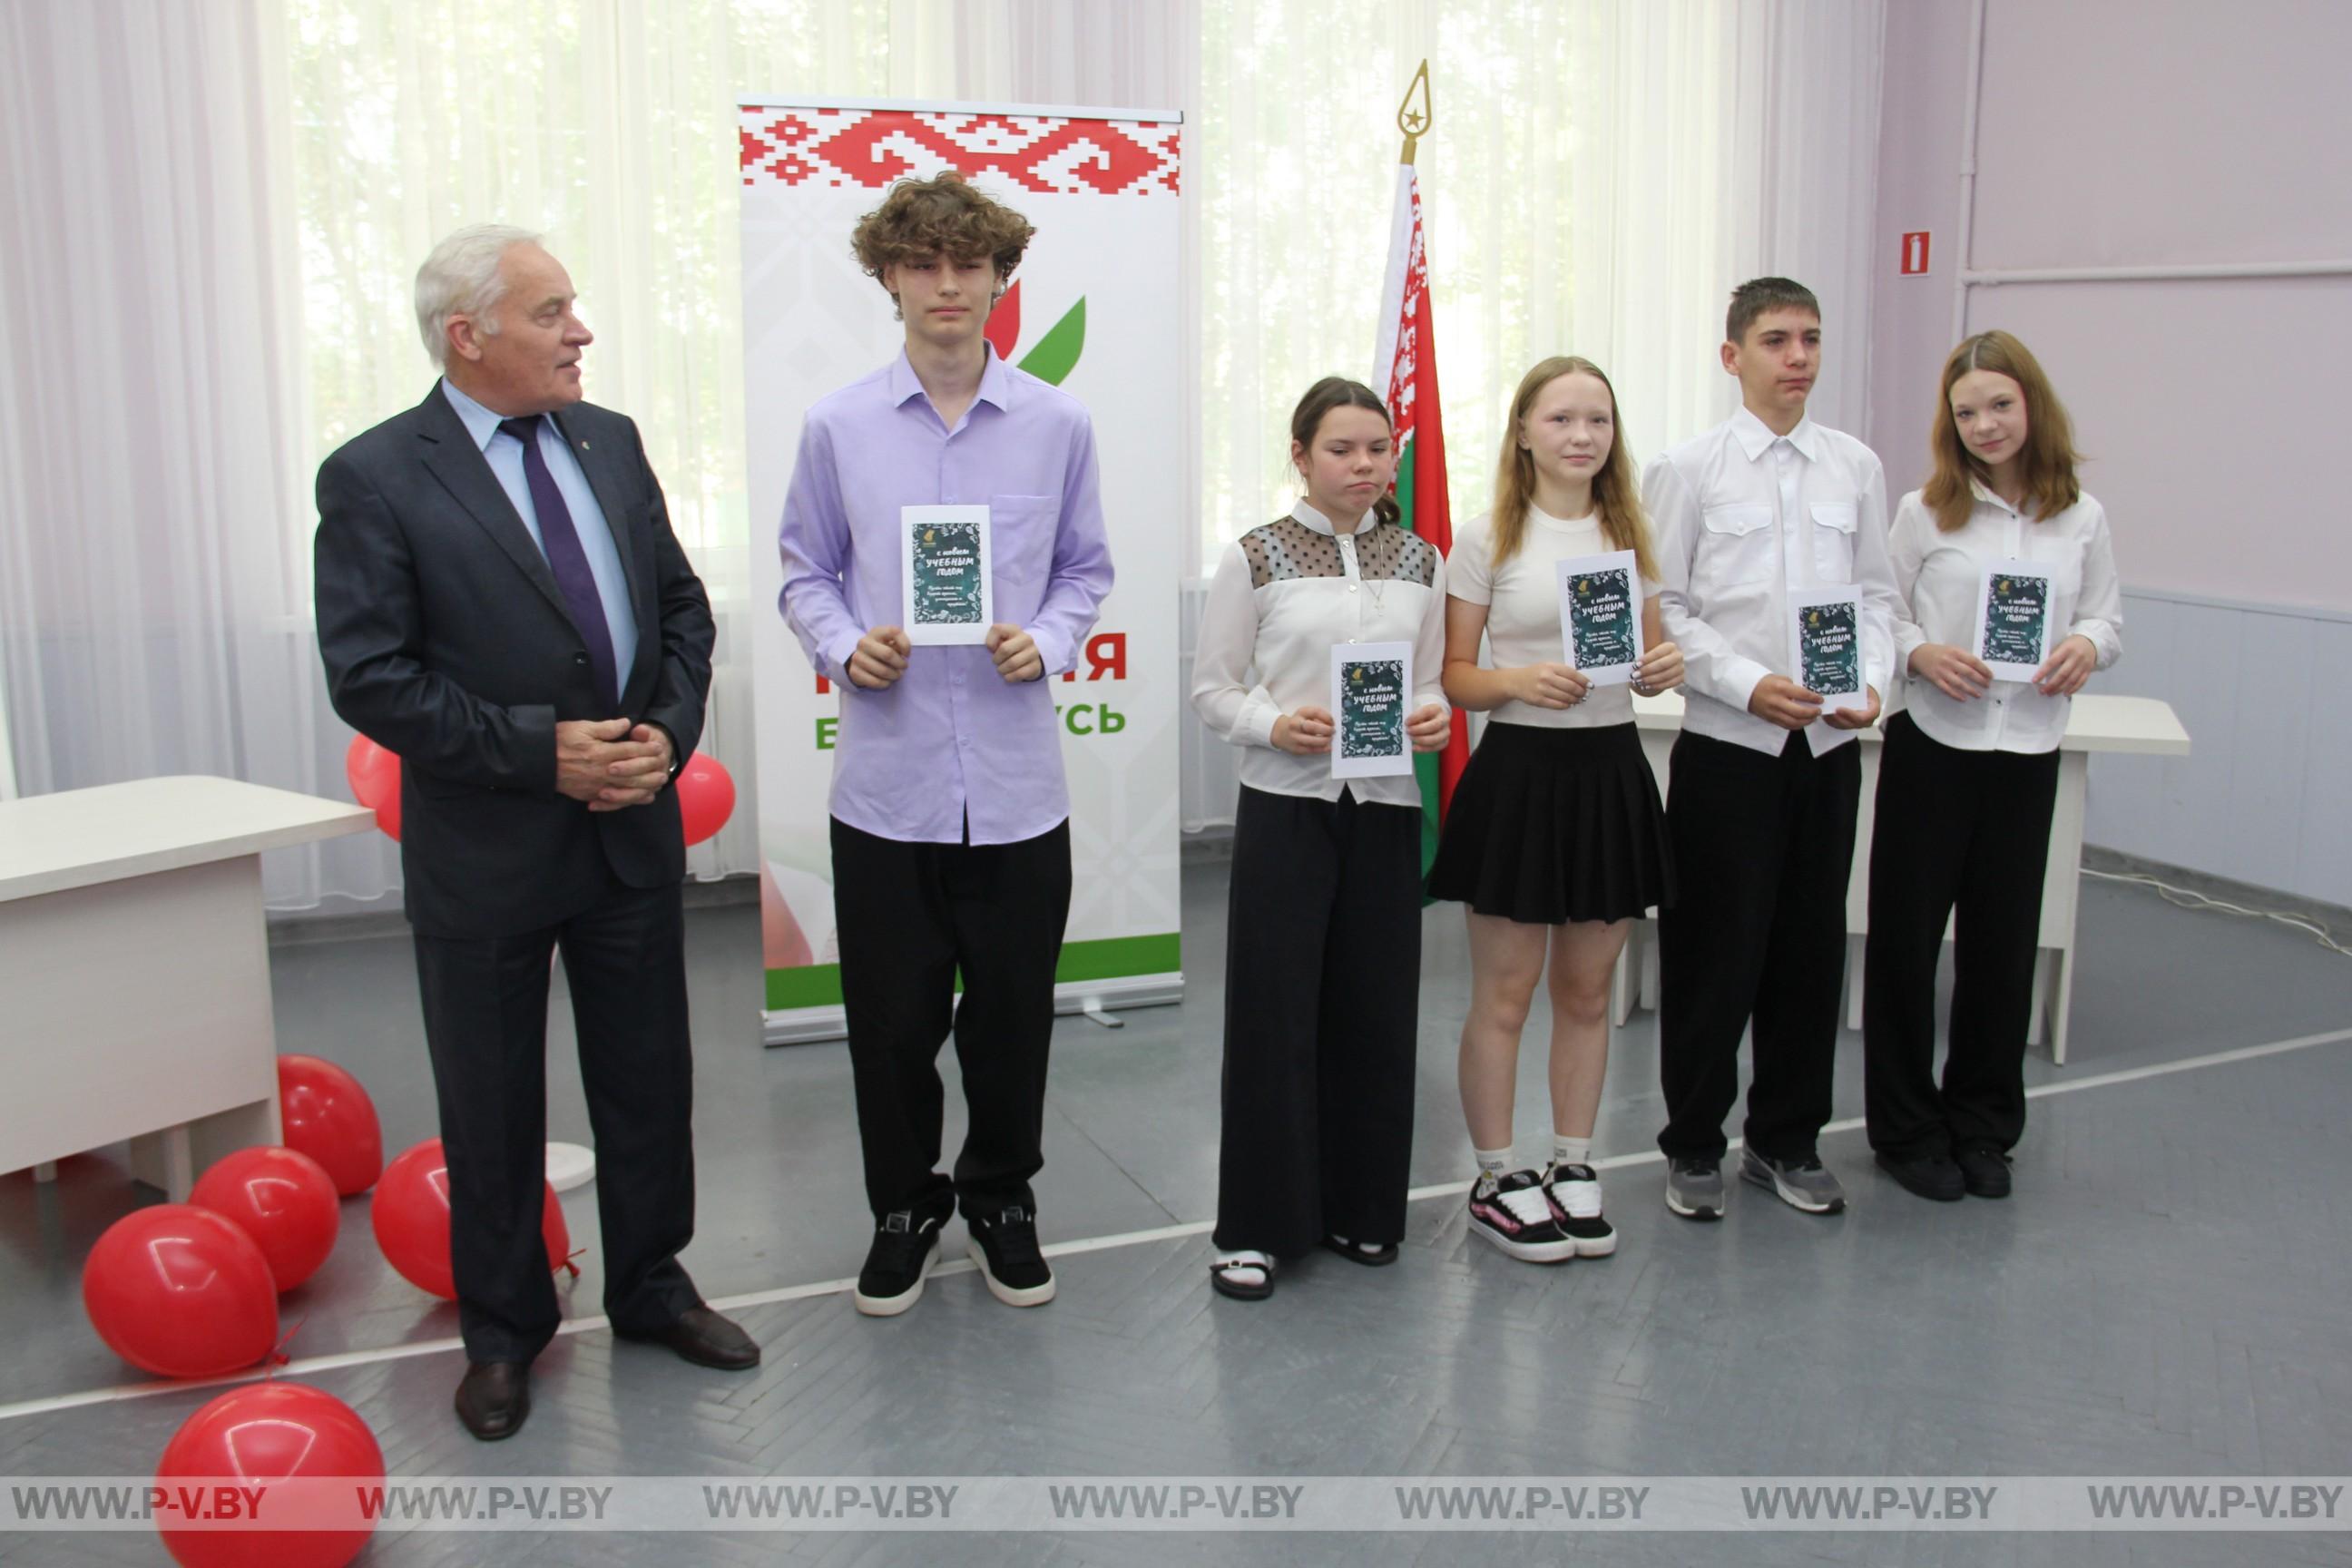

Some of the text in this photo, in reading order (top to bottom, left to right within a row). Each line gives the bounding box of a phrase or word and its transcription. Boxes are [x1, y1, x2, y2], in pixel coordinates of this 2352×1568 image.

[926, 557, 974, 568] УЧЕБНЫМ
[936, 567, 964, 576] ГОДОМ
[1582, 602, 1625, 616] УЧЕБНЫМ
[1592, 612, 1616, 623] ГОДОМ
[1811, 633, 1851, 646] УЧЕБНЫМ
[1353, 693, 1396, 704] УЧЕБНЫМ
[1362, 704, 1387, 712] ГОДОМ
